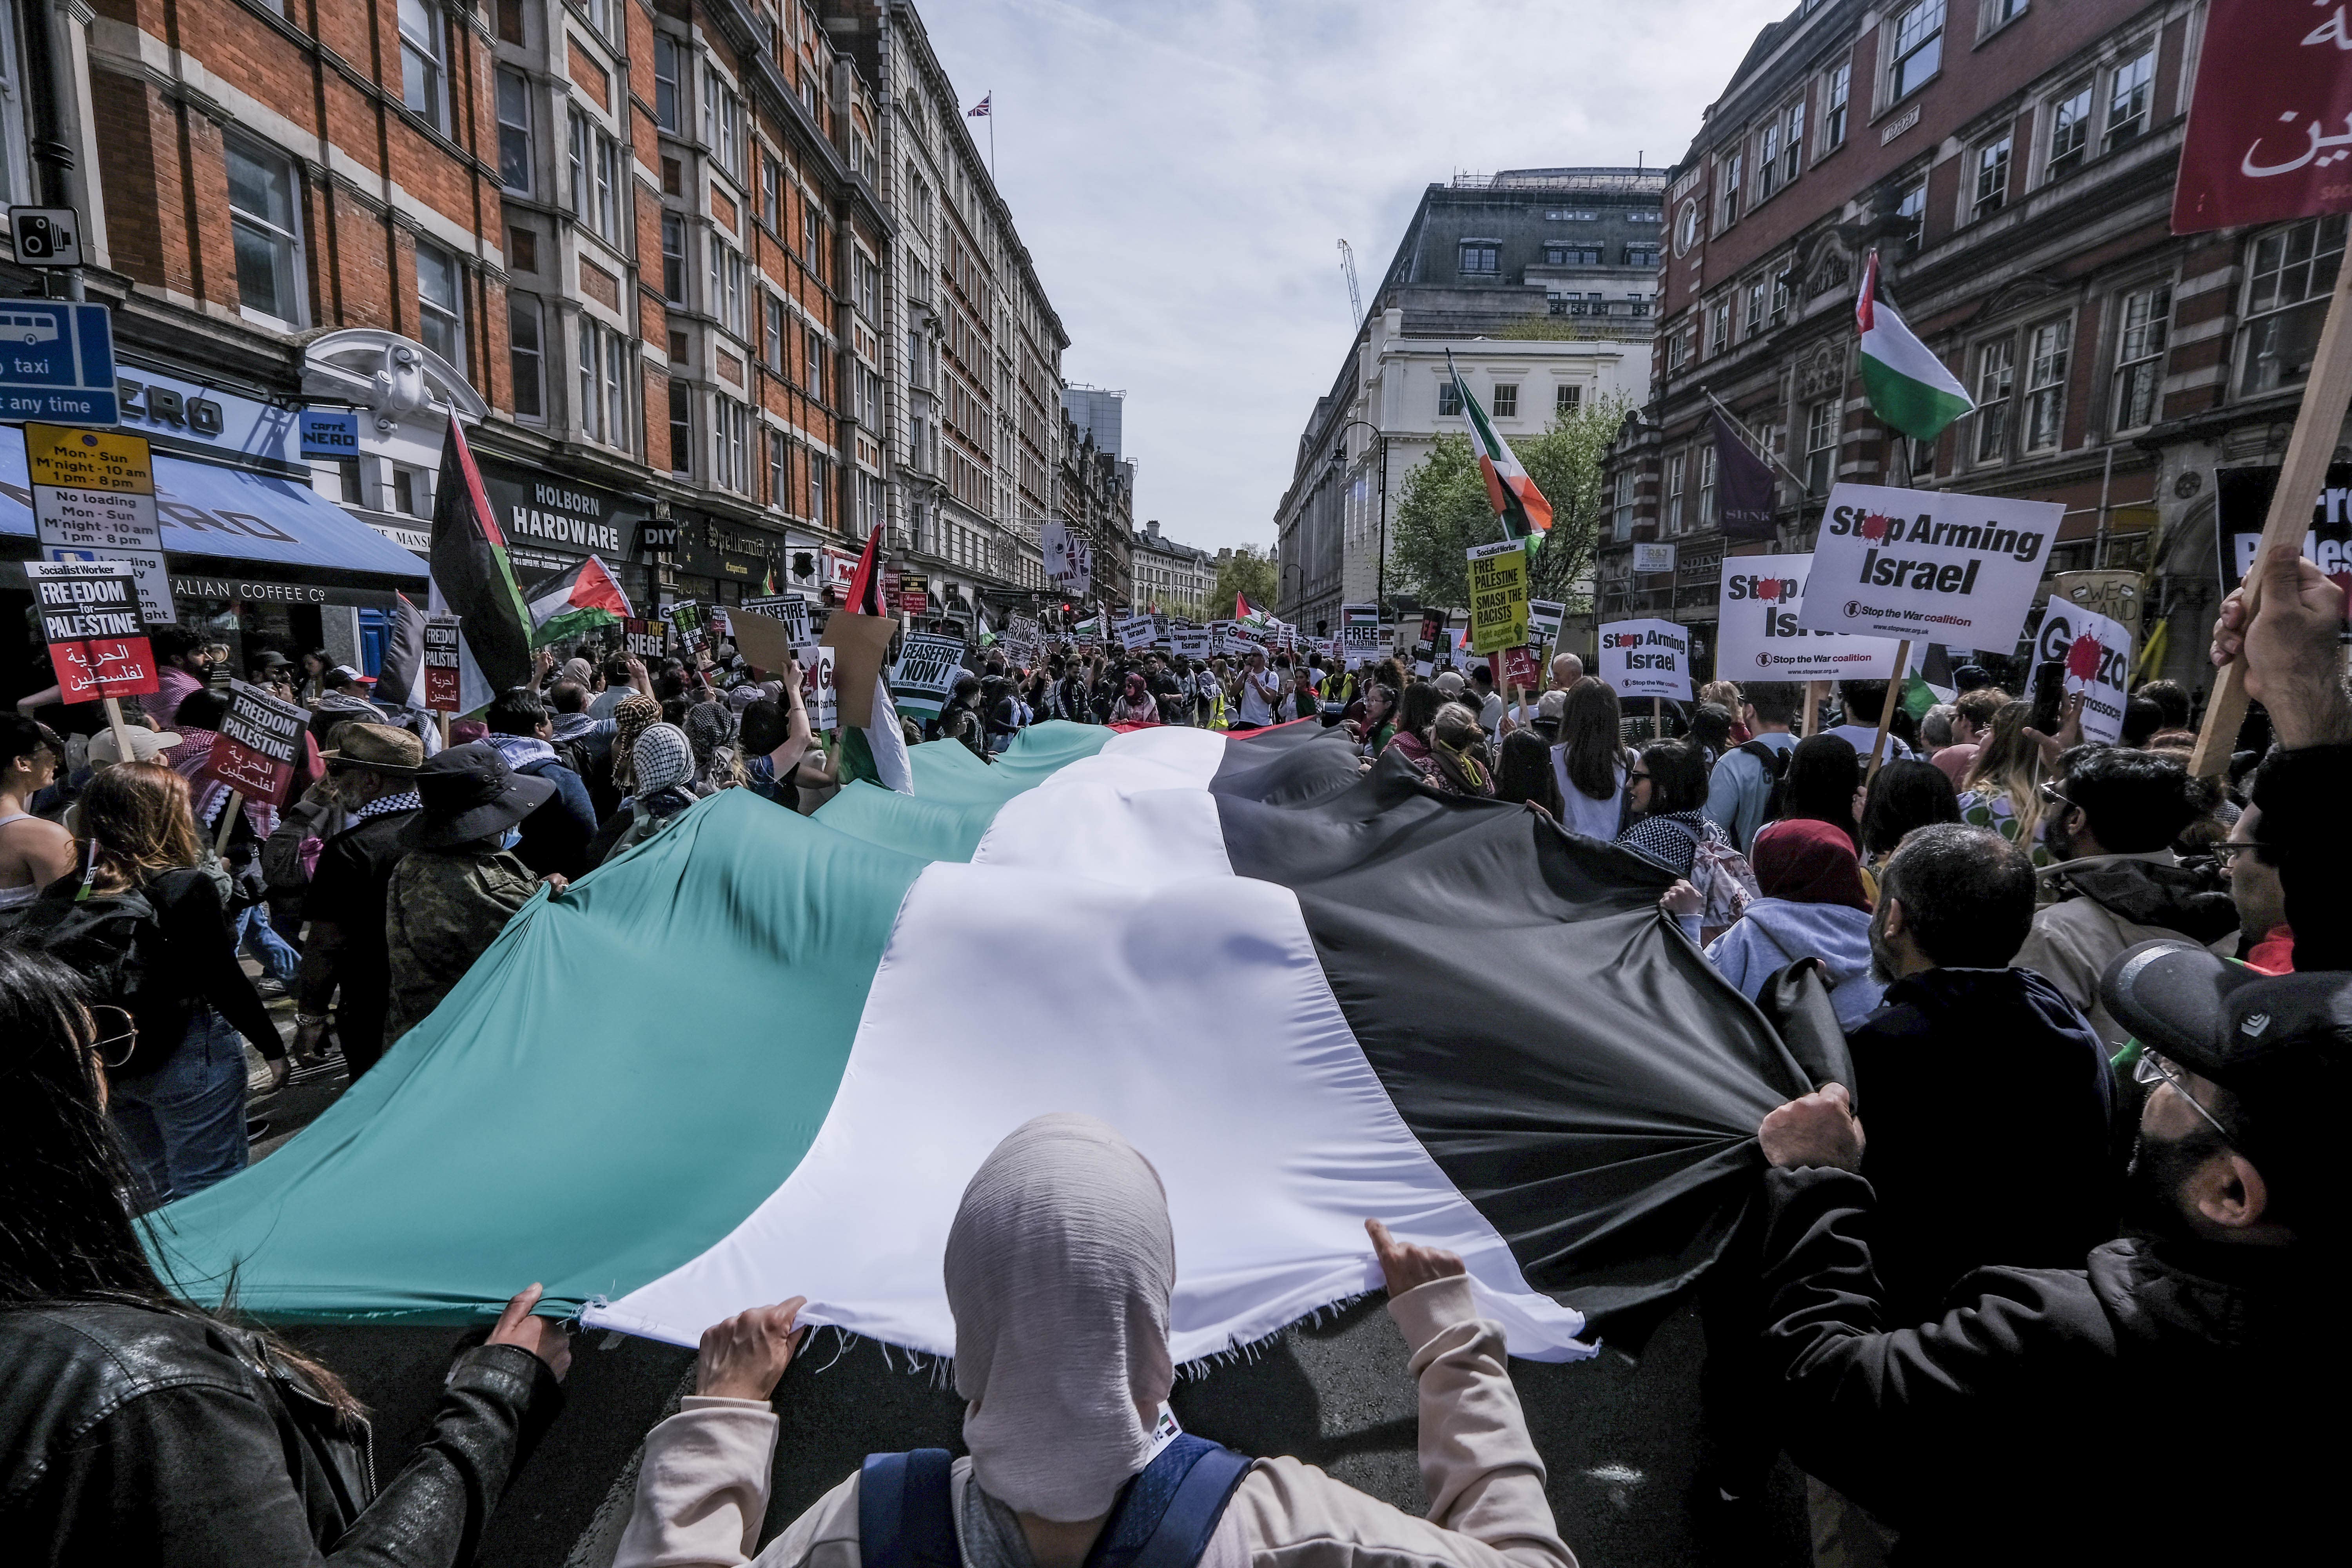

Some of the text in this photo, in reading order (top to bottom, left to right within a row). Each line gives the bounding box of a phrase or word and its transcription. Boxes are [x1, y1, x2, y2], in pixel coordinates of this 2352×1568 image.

[906, 222, 927, 263] HOTEL
[15, 358, 49, 374] taxi
[11, 396, 91, 413] any time
[118, 377, 224, 434] ERO
[303, 432, 356, 446] NERO
[54, 446, 128, 463] Mon Sun
[36, 457, 146, 478] M'night 10 am
[54, 472, 133, 488] 1 pm 8 pm
[56, 491, 136, 508] No loading
[535, 483, 599, 516] HOLBORN
[62, 506, 135, 520] Mon Sun
[944, 504, 990, 536] BONNINGTON HOTEL
[44, 518, 102, 531] M'night
[113, 524, 129, 533] 10
[513, 505, 619, 551] HARDWARE
[1829, 506, 2044, 562] Stp Arming
[62, 531, 141, 545] 1 pm 8 pm
[396, 532, 430, 548] MANSI
[645, 528, 677, 544] DIY
[1474, 558, 1495, 575] FREE
[1860, 548, 1982, 595] Israel
[1475, 568, 1518, 590] PALESTINE
[39, 581, 127, 604] FREEDOM
[169, 579, 303, 601] ALIAN COFFEE
[1728, 575, 1798, 604] Stp
[2087, 581, 2119, 600] WE
[1477, 588, 1523, 610] SMASH THE
[79, 603, 94, 614] for
[1477, 605, 1512, 625] RACISTS
[1862, 606, 1972, 627] Stop the War coalition
[2072, 599, 2138, 621] TAND
[45, 612, 141, 639] PALESTINE
[628, 619, 664, 636] END THE
[1013, 617, 1037, 632] STOP
[1127, 627, 1146, 639] Israel
[1131, 619, 1152, 629] Arming
[1478, 625, 1512, 640] Fight against
[1873, 624, 1929, 635] www.stopwar.org.uk
[426, 628, 456, 644] FREEDOM
[1008, 627, 1035, 644] ARMING
[1212, 635, 1225, 644] FR
[1228, 626, 1259, 642] Gza
[1344, 627, 1378, 640] FREE
[1603, 630, 1685, 655] Stp Arming
[626, 633, 663, 657] SIEGE
[1479, 635, 1513, 651] Islamophobia
[66, 644, 129, 668] الحرية
[902, 643, 962, 665] CEASEFIRE
[1506, 652, 1525, 667] الحري
[1626, 651, 1675, 671] Israel
[1773, 655, 1795, 665] Stop
[1833, 654, 1871, 662] coalition
[2041, 617, 2127, 693] Gza
[70, 664, 144, 691] لفلسطين
[1506, 664, 1530, 680] لفلسطي
[233, 695, 298, 737] FREEDOM
[254, 723, 265, 733] for
[223, 717, 295, 761] PALESTINE
[229, 745, 272, 775] الحرية
[218, 762, 276, 793] لفلسطين
